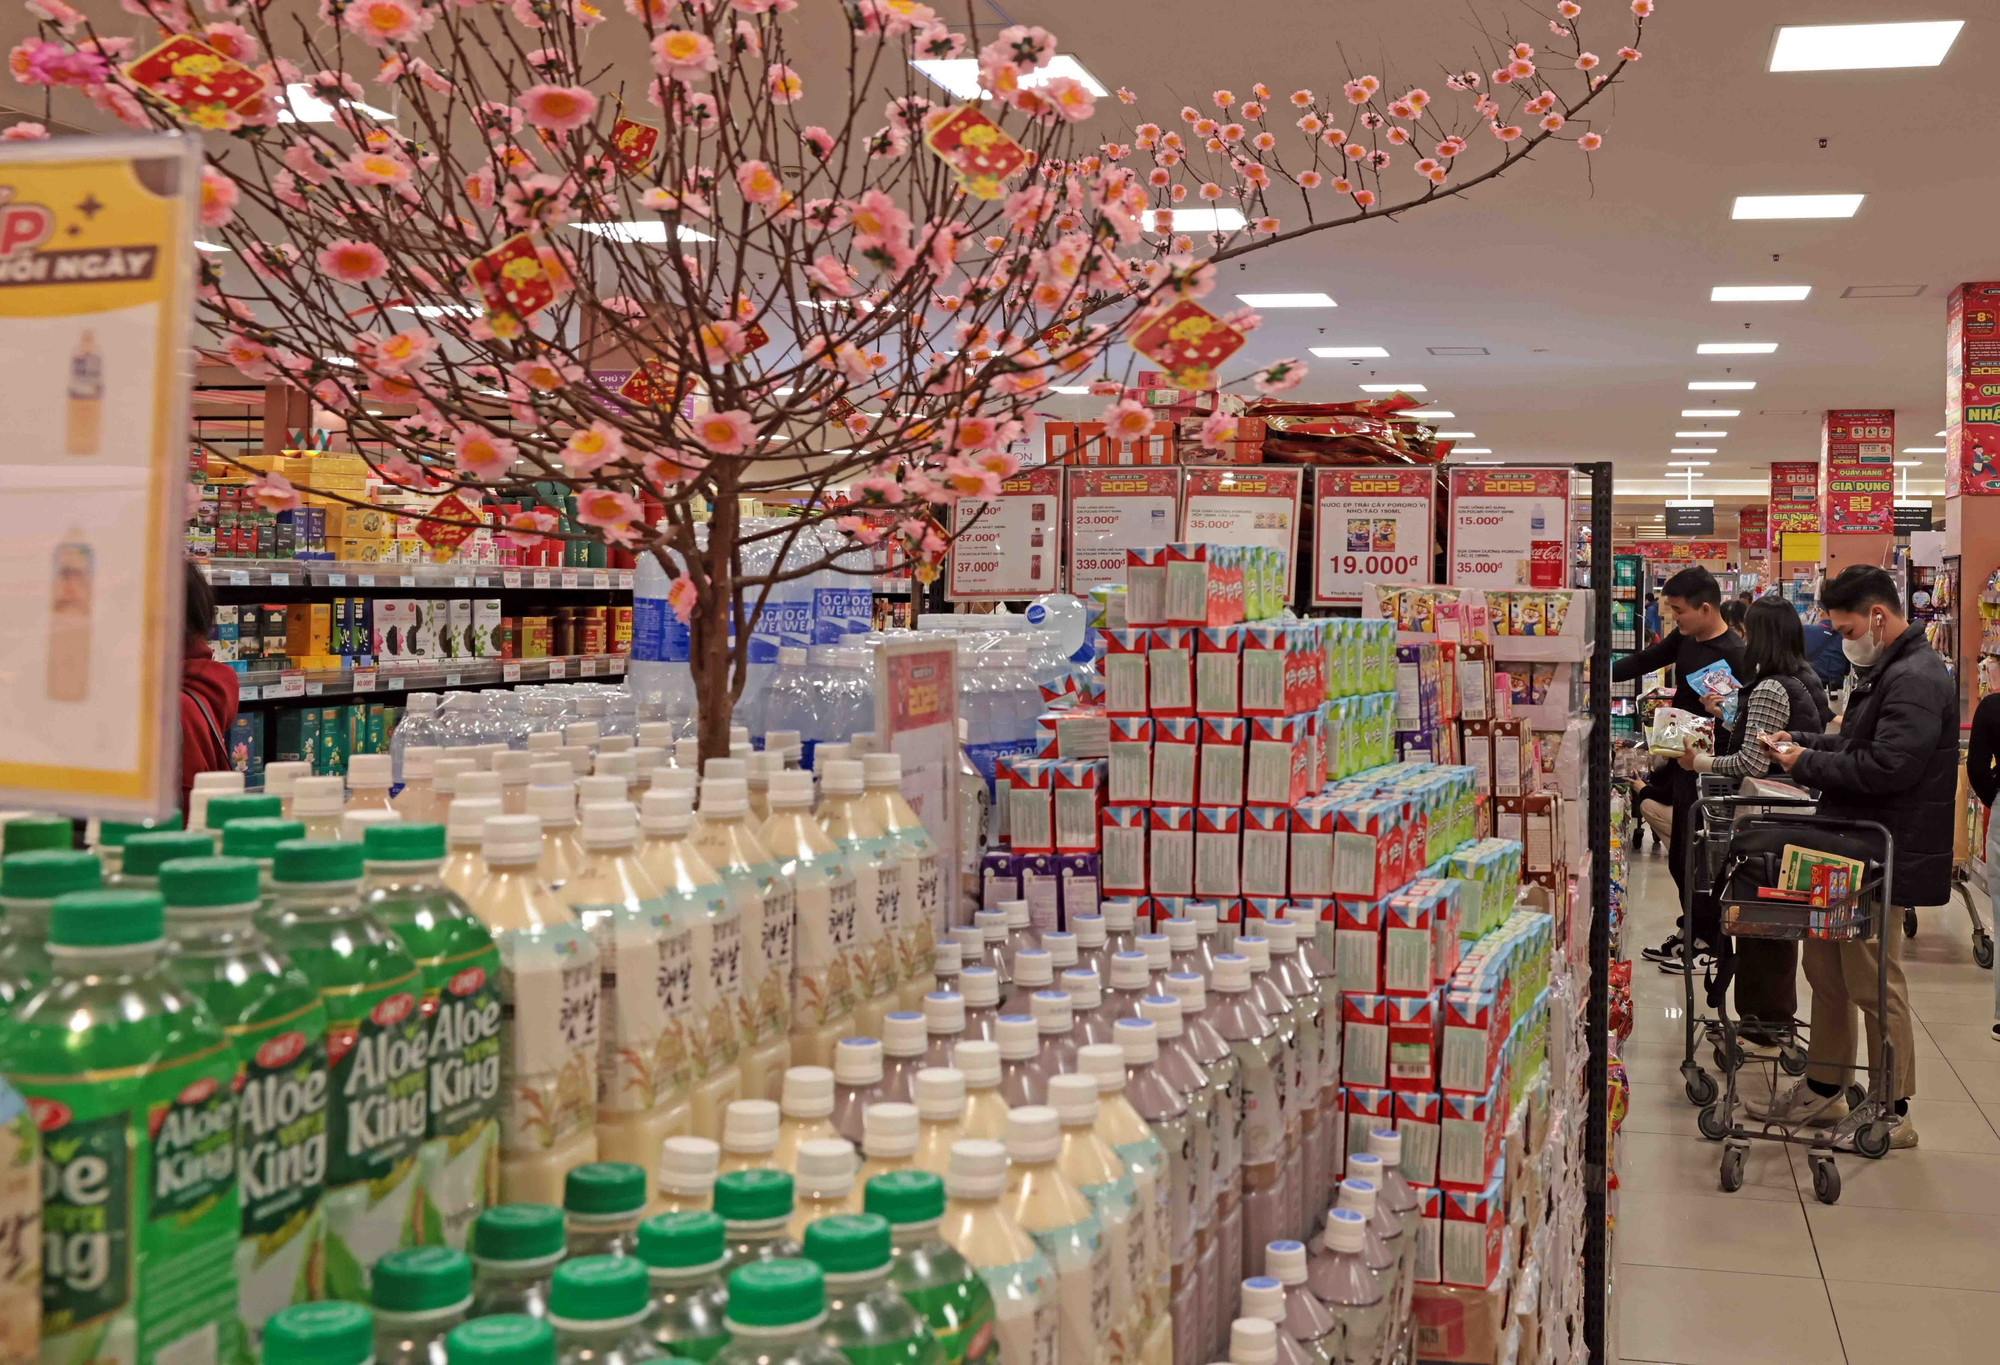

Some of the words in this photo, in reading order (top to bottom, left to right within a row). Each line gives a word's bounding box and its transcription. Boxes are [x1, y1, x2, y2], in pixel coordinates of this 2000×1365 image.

[599, 375, 618, 383] CHÚ
[1002, 481, 1030, 491] 25
[1101, 481, 1148, 493] 2025
[1218, 481, 1266, 493] 2025
[1350, 481, 1400, 493] 2025
[1484, 480, 1535, 493] 2025
[1832, 482, 1853, 491] GIA
[1856, 482, 1890, 492] DỤNG
[1076, 515, 1119, 524] 23.000đ
[1191, 520, 1234, 528] 35.000đ
[1460, 516, 1503, 525] 15.000đ
[959, 533, 999, 542] 37.000đ
[958, 561, 999, 572] 37.000đ
[1076, 559, 1126, 570] 339.000đ
[1330, 555, 1418, 575] 19.000đ
[1457, 562, 1502, 573] 35.000đ
[429, 1002, 499, 1056] Aloe
[344, 1031, 429, 1095] Aloe
[430, 1054, 498, 1113] King
[240, 1070, 327, 1135] Aloe
[156, 1102, 233, 1154] Aloe
[348, 1090, 426, 1156] King
[157, 1144, 233, 1197] King
[238, 1134, 326, 1208] King
